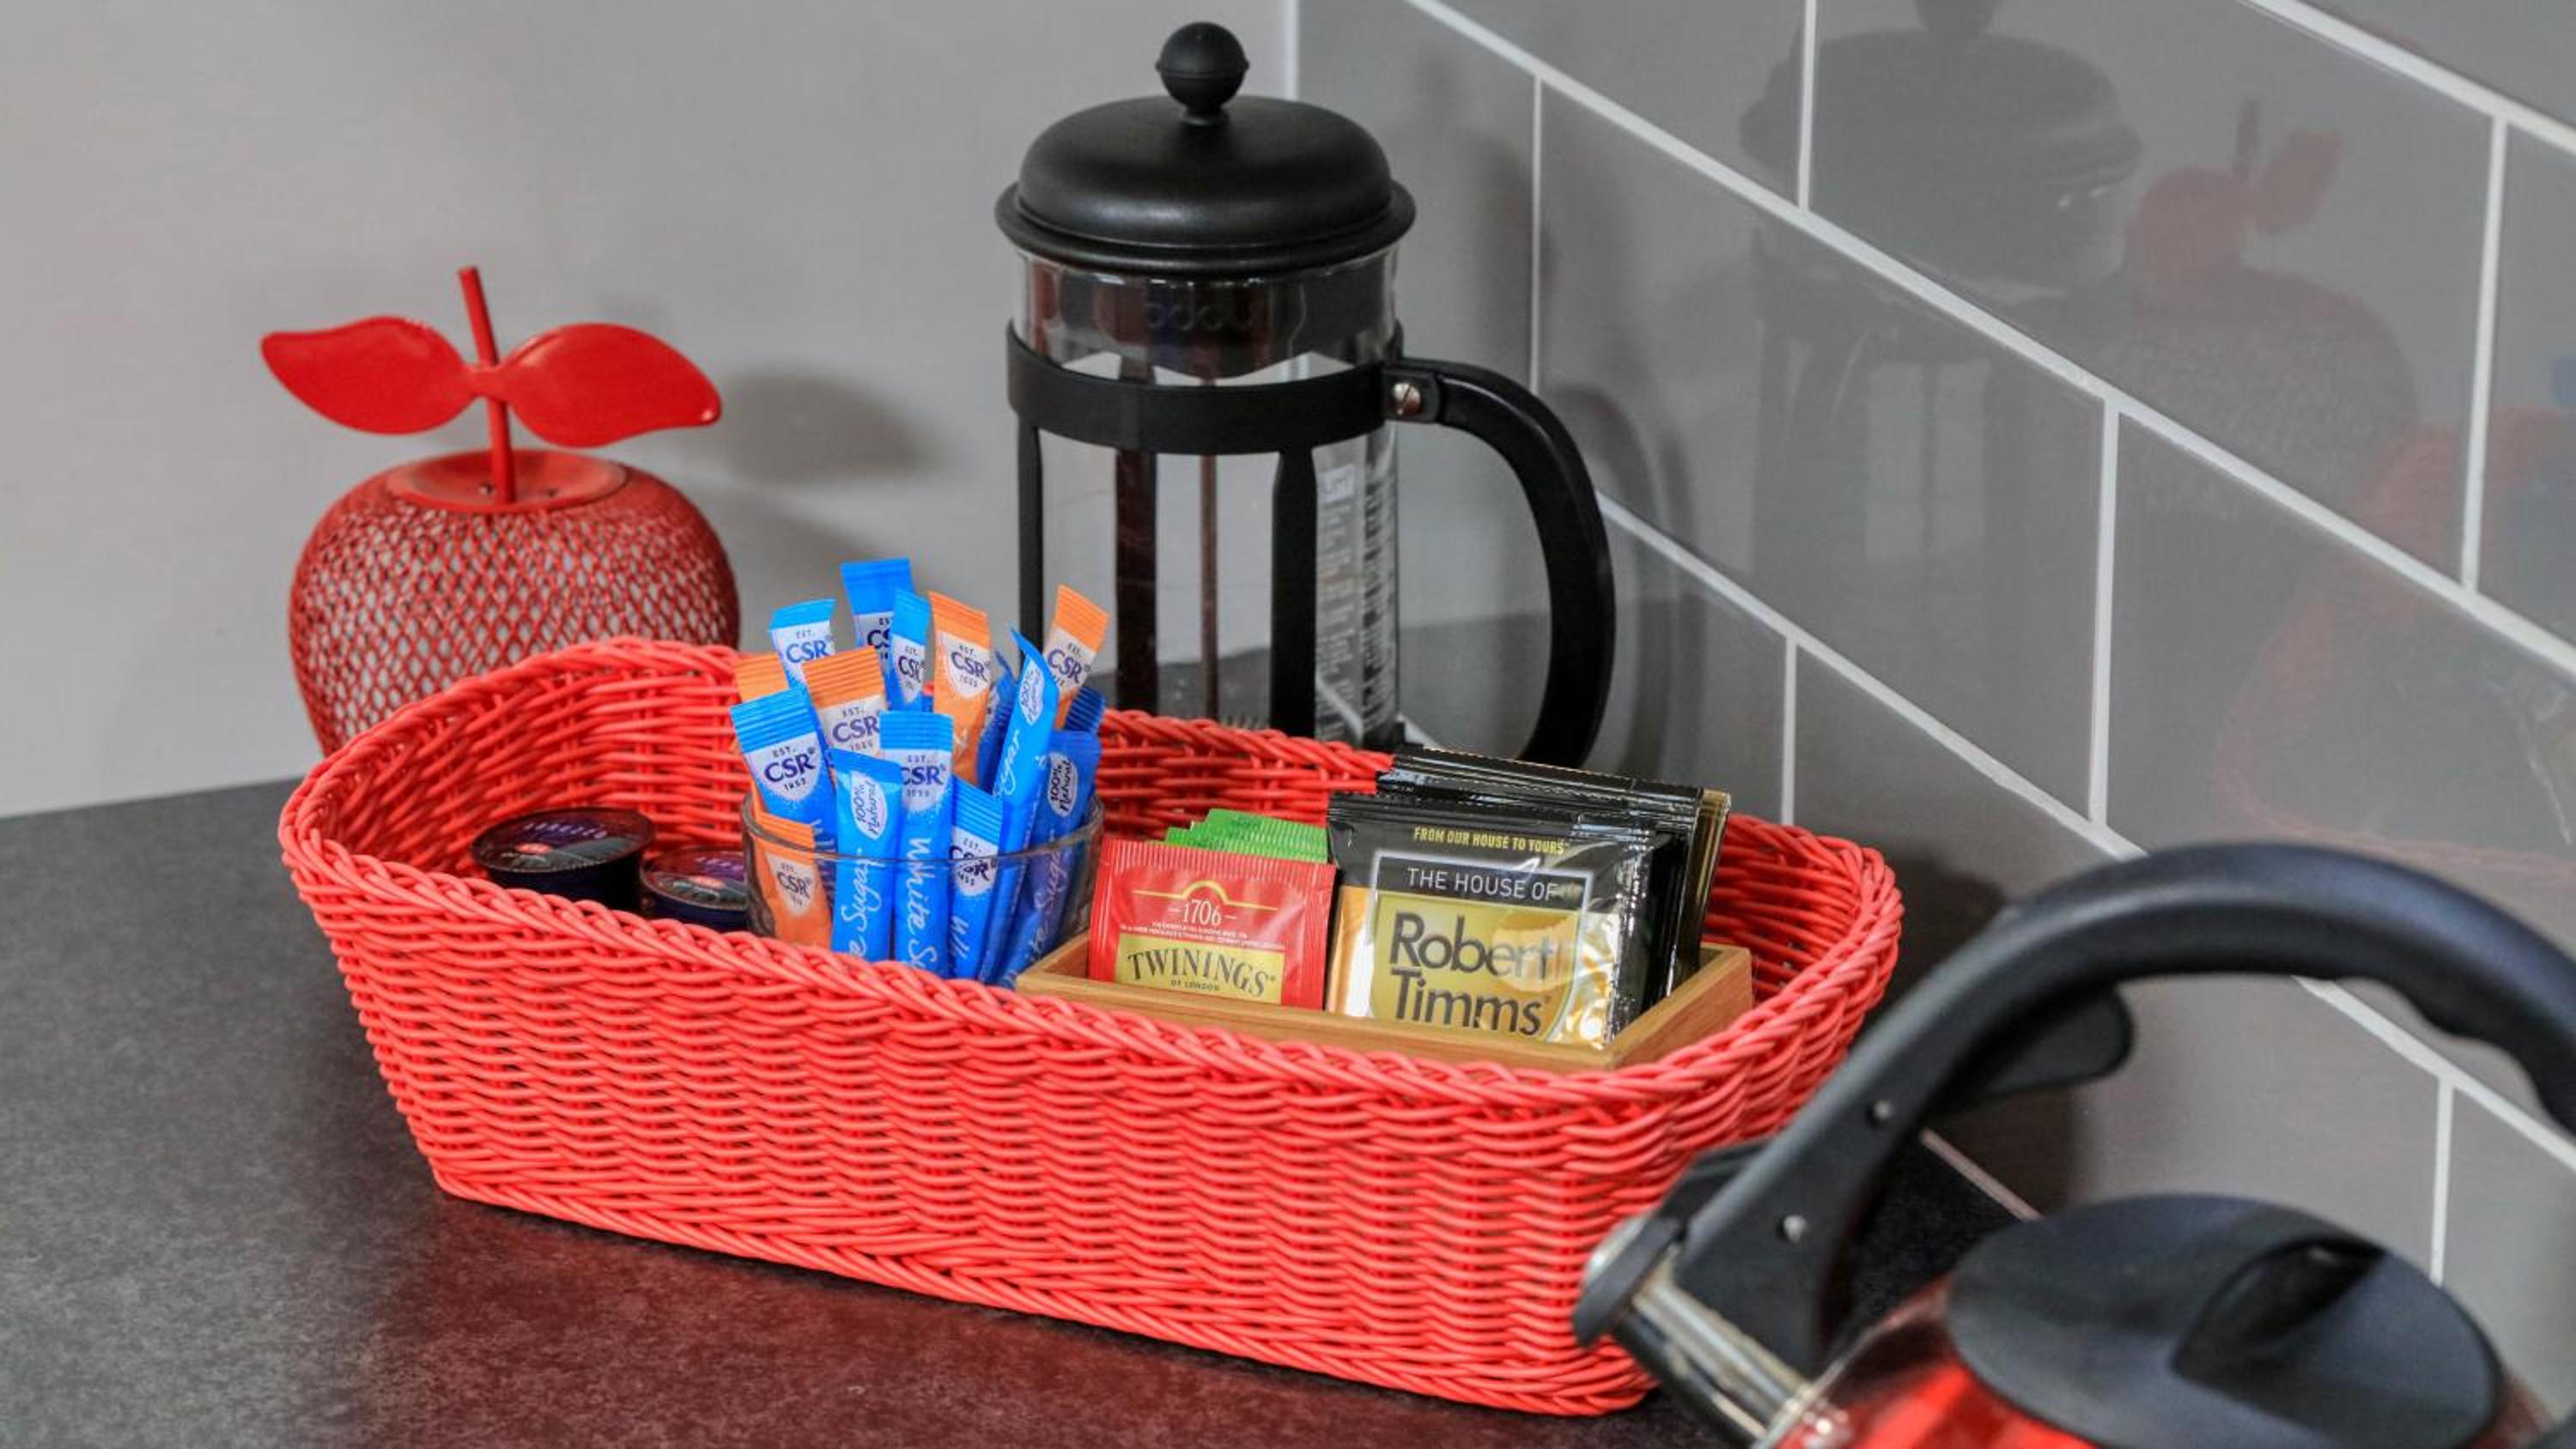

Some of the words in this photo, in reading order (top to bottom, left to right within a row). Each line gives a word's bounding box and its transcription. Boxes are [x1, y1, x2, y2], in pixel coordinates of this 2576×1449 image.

[951, 652, 988, 682] CSR
[1048, 648, 1080, 684] CSR
[832, 715, 879, 743] CSR
[764, 753, 816, 783] CSR
[1413, 827, 1445, 841] FROM
[1447, 830, 1470, 846] OUR
[1473, 833, 1510, 850] HOUSE
[1511, 837, 1527, 852] TO
[1528, 840, 1565, 855] YOURS
[1407, 868, 1449, 890] THE
[1454, 871, 1527, 900] HOUSE
[1531, 881, 1559, 900] OF
[1182, 898, 1223, 926] 1706
[1389, 911, 1553, 980] Robert
[1127, 947, 1271, 998] TWININGS
[1390, 966, 1542, 1036] Timms
